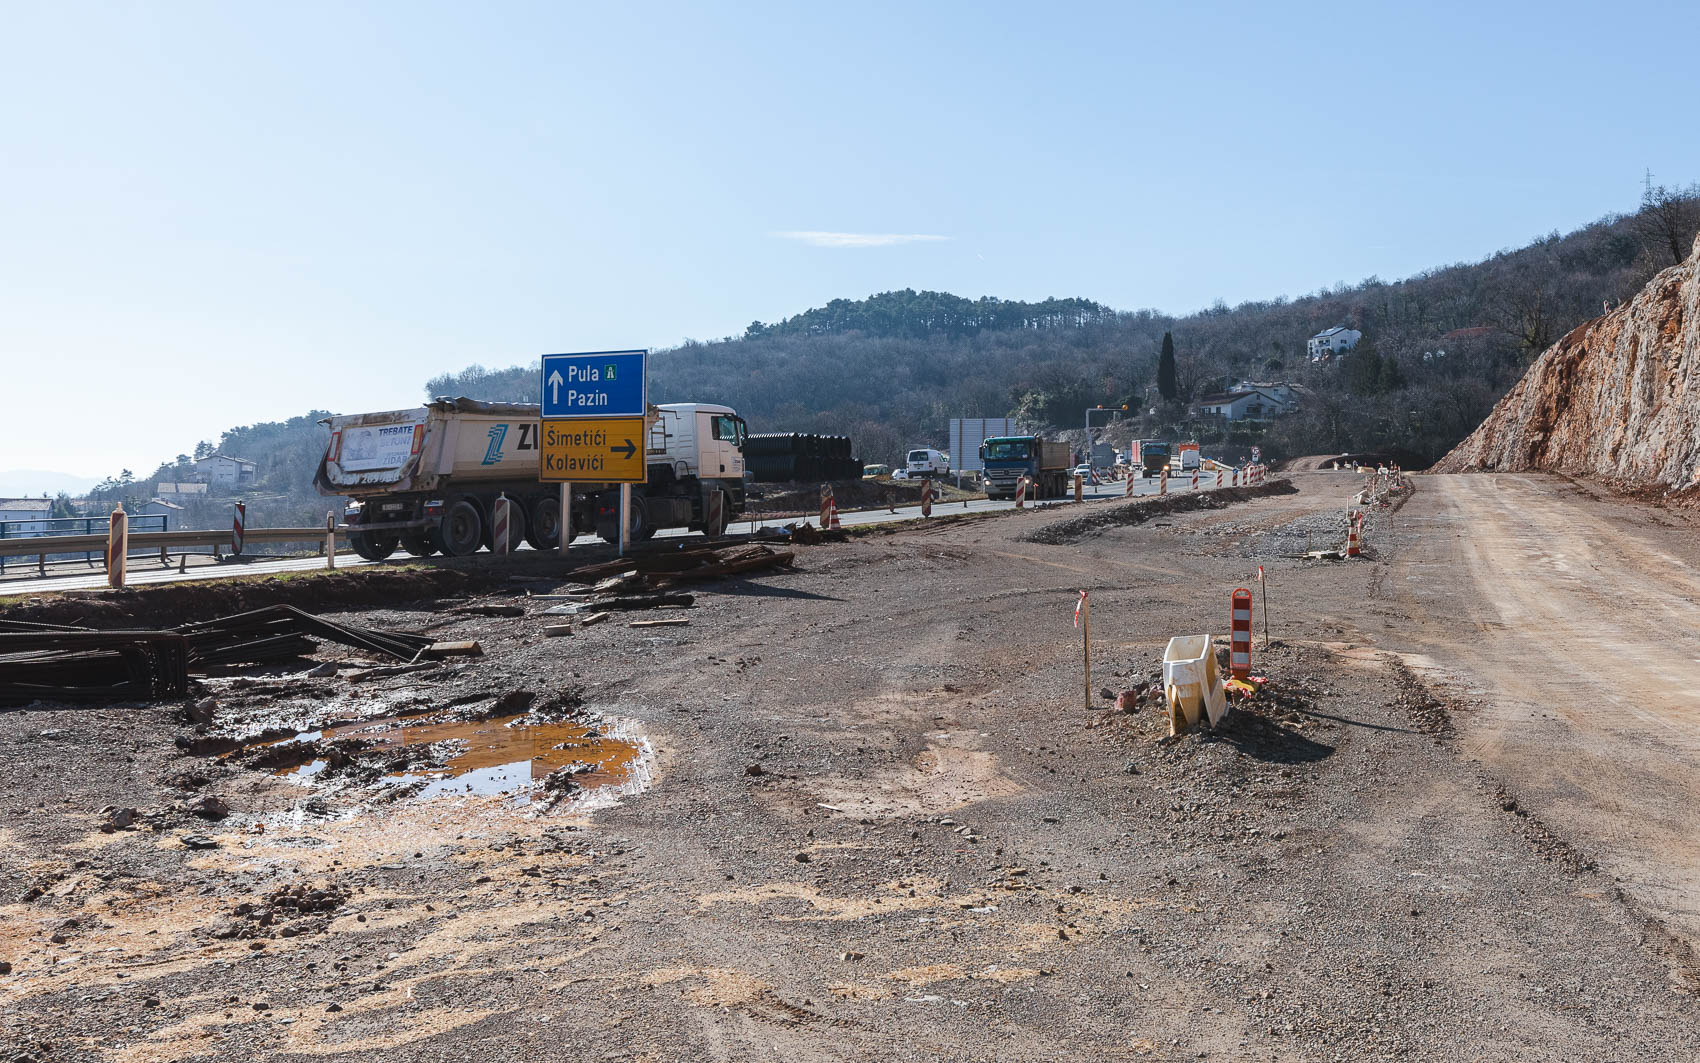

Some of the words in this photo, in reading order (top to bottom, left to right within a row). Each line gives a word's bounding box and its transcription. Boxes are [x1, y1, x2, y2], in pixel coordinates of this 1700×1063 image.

[568, 365, 599, 382] Pula
[568, 390, 608, 406] Pazin
[547, 425, 606, 446] Šimetići
[546, 454, 603, 471] Kolavići
